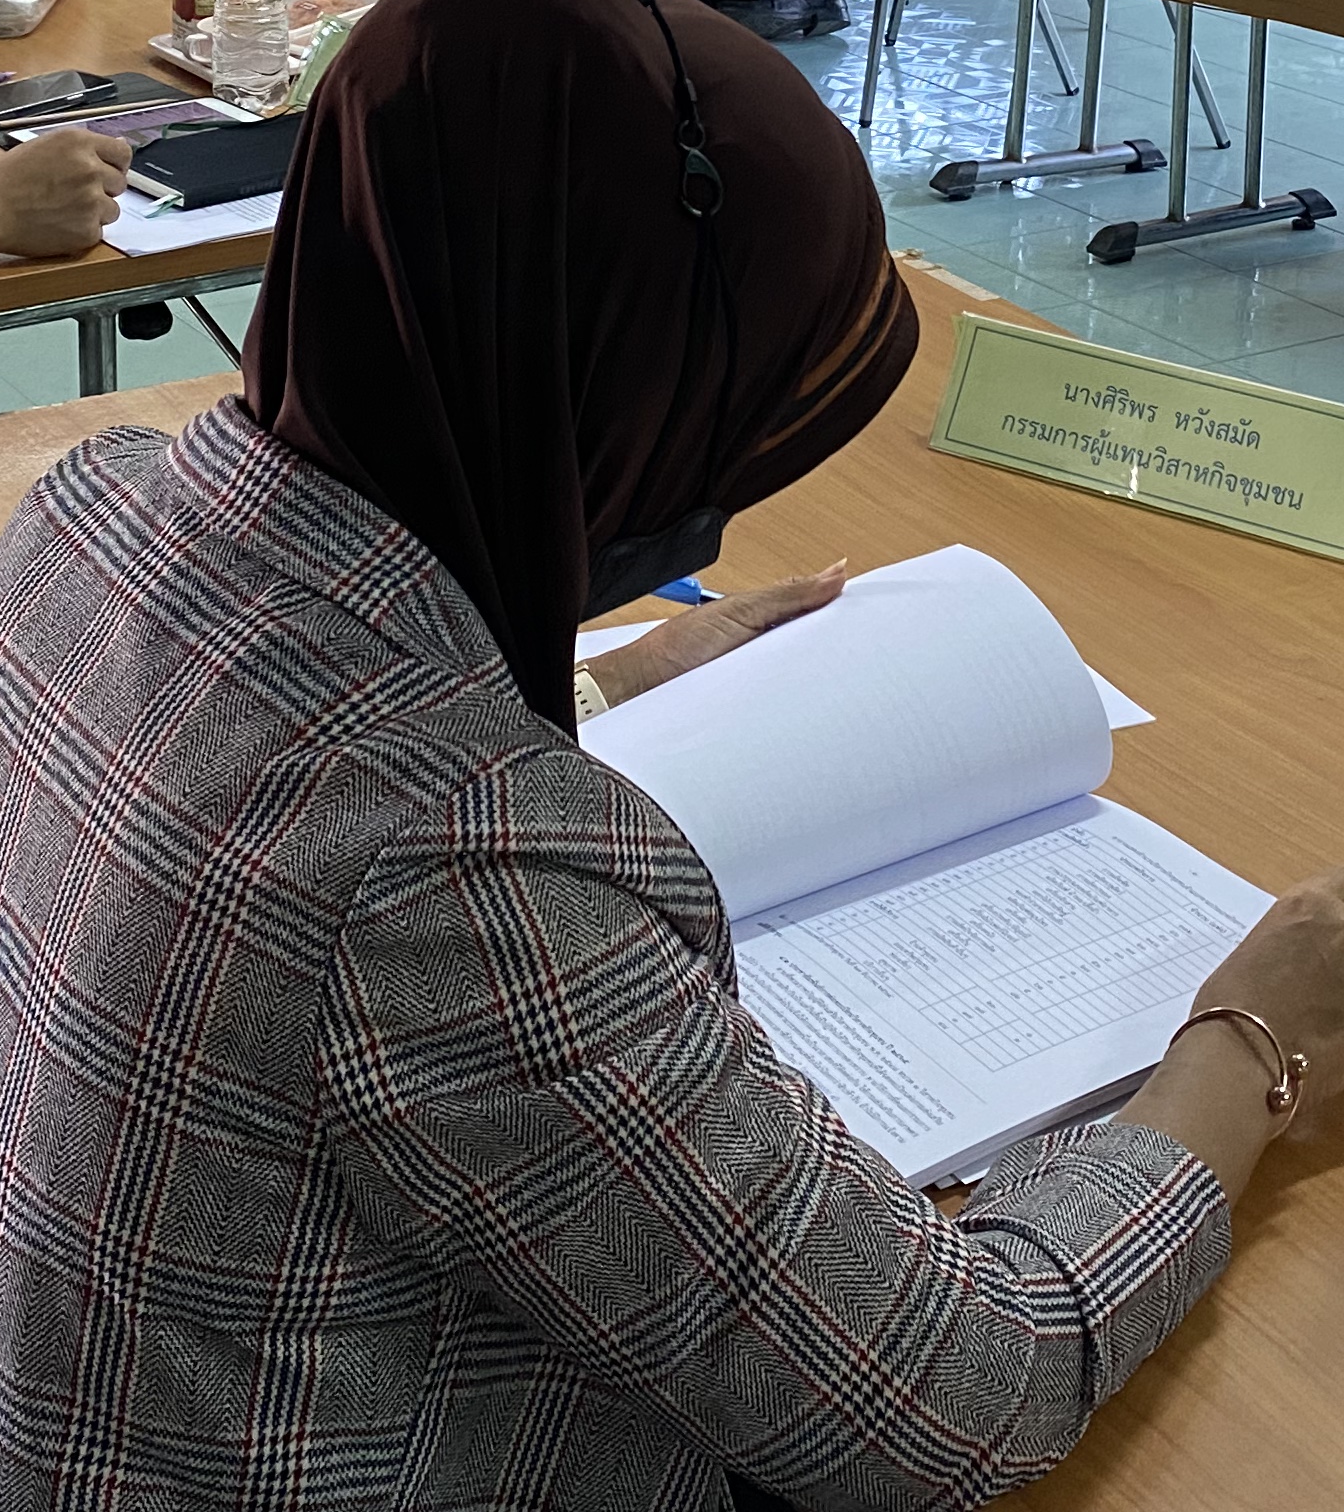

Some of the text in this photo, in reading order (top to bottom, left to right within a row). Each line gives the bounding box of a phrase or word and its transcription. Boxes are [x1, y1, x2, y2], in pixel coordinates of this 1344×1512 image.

[1064, 383, 1261, 450] นางศิริพร หวังสมัด
[1001, 413, 1304, 511] กรรมการผู้แทนวิสาหกิจชุมชน
